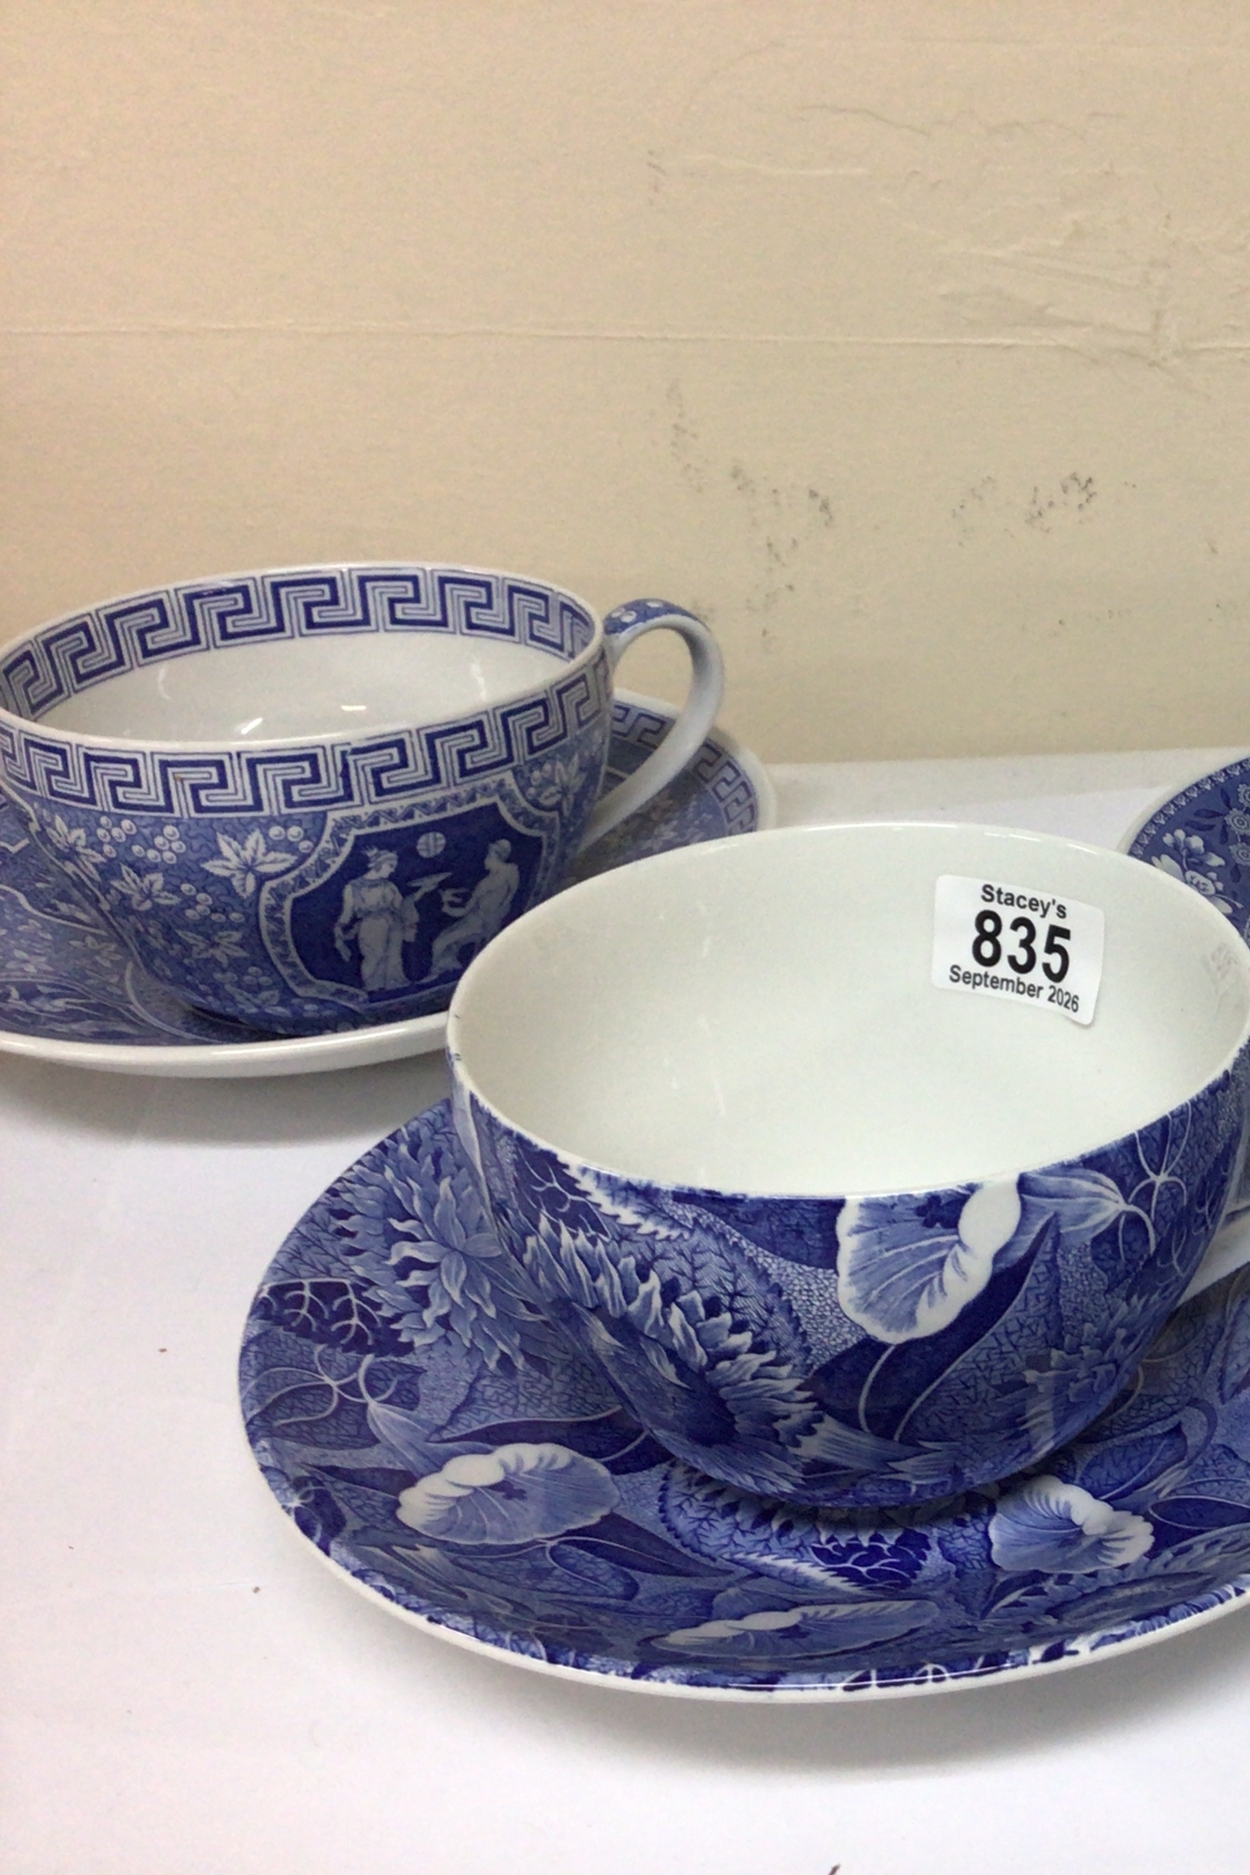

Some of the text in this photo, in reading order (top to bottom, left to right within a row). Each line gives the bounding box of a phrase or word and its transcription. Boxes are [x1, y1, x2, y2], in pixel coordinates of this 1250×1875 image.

[981, 884, 1067, 919] Stacey's
[972, 909, 1071, 983] 835
[949, 964, 1080, 1013] September 2026
